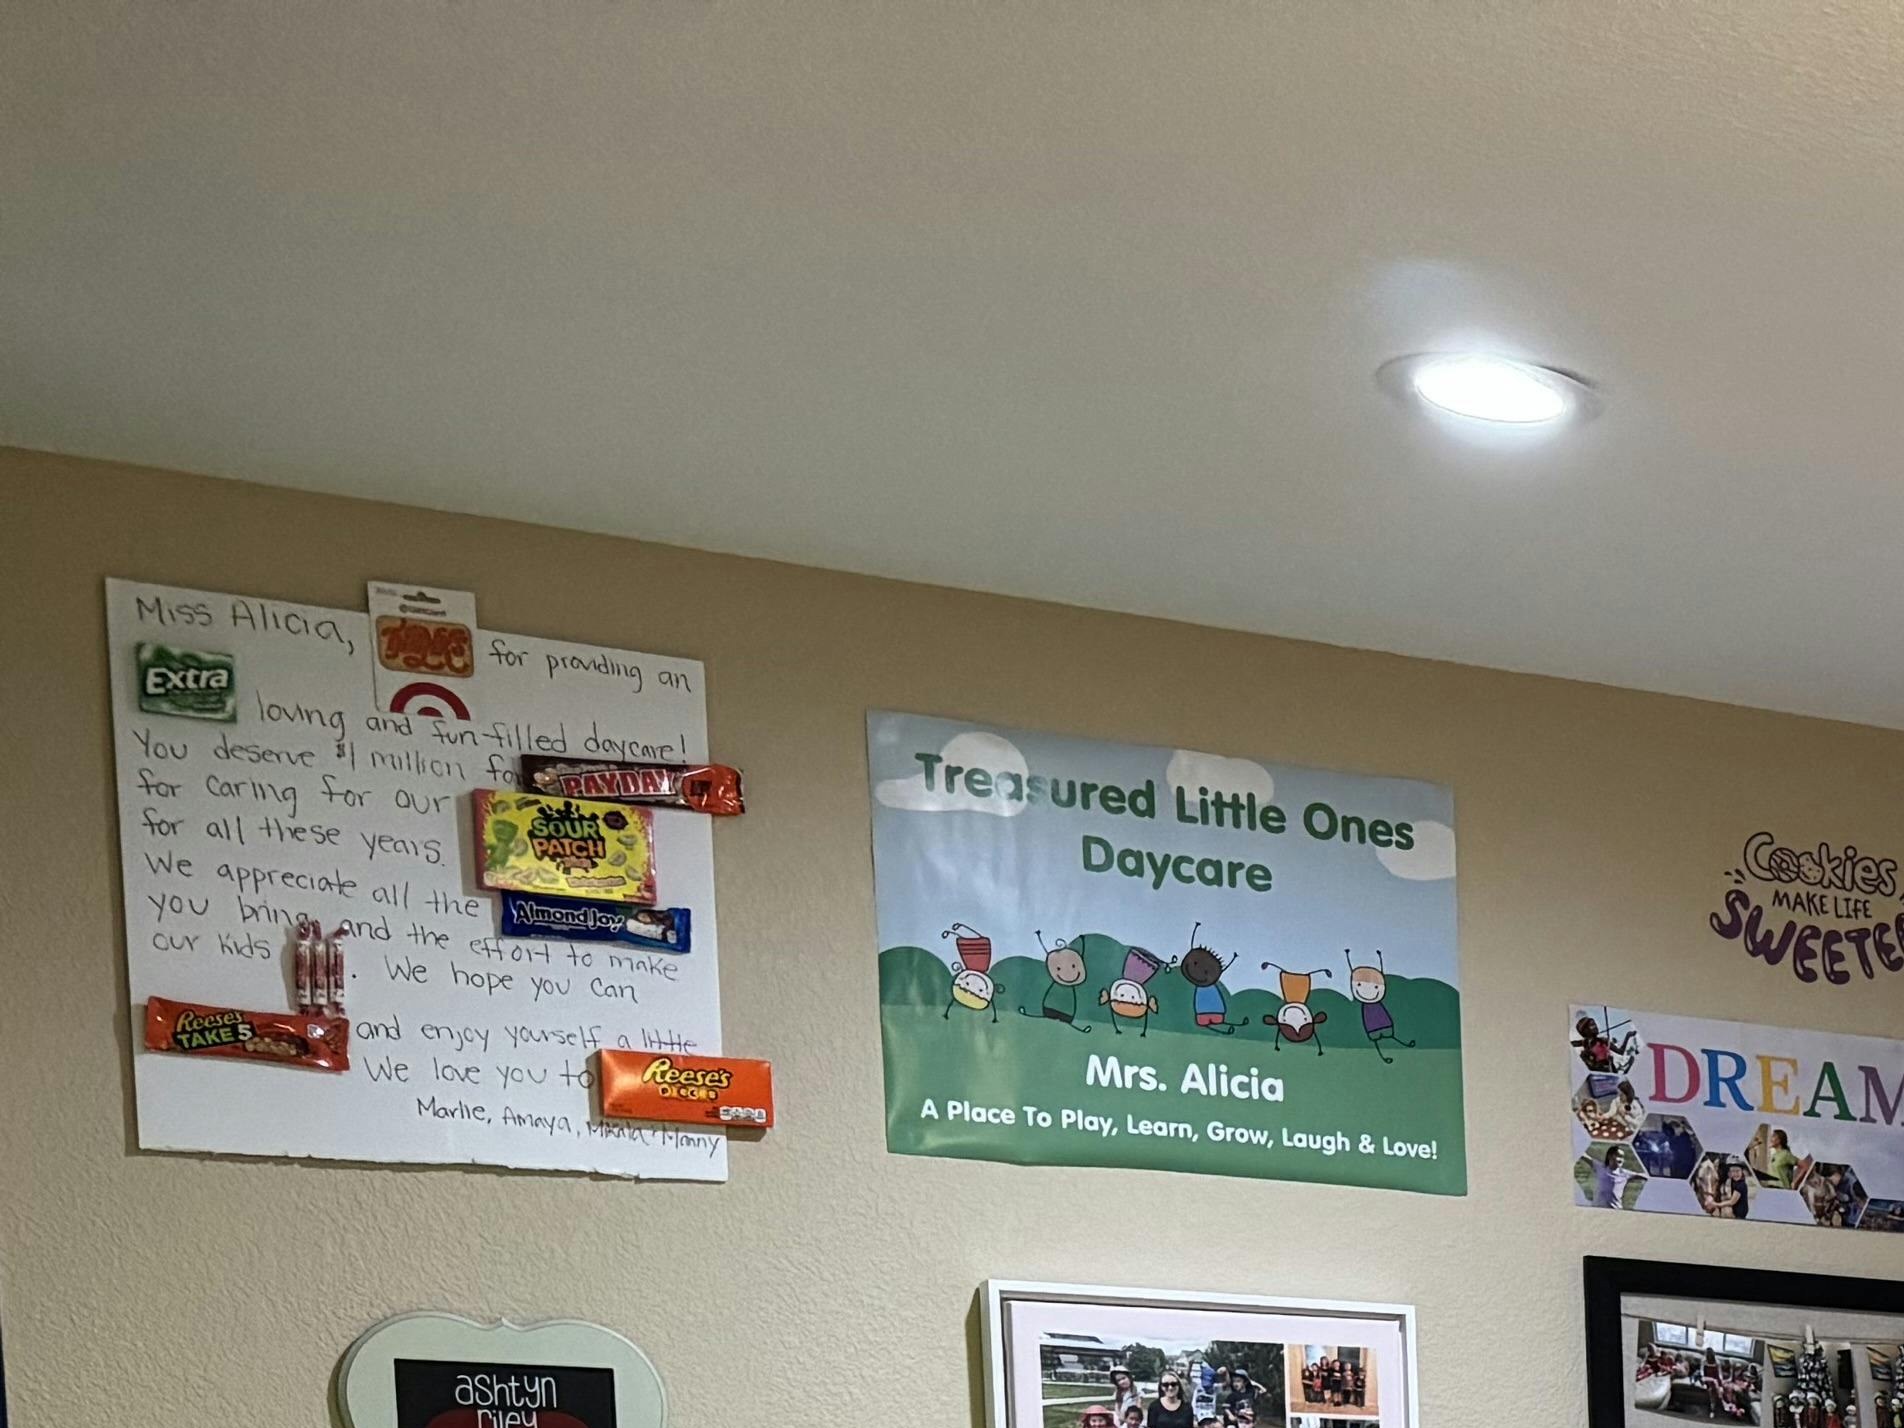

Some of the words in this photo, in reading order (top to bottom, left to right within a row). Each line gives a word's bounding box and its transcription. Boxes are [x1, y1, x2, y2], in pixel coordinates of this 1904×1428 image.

[136, 597, 213, 627] Miss
[488, 638, 529, 667] for
[548, 653, 643, 693] providing
[657, 670, 692, 693] an
[145, 664, 230, 695] Extra
[256, 690, 346, 742] loving
[366, 713, 414, 737] and
[584, 721, 687, 765] daycare!
[132, 728, 188, 761] You
[213, 734, 316, 768] deserve
[370, 749, 467, 782] million
[136, 767, 183, 798] for
[205, 774, 298, 818] caring
[321, 773, 373, 808] for
[394, 788, 451, 815] our
[560, 769, 676, 797] PAYDAY
[914, 752, 1157, 820] Treasured
[1175, 785, 1287, 834] Little
[1302, 802, 1415, 852] Ones
[140, 806, 186, 837] for
[205, 815, 245, 846] all
[258, 816, 341, 846] these
[532, 818, 599, 838] SOUR
[532, 837, 606, 859] PATCH
[143, 851, 194, 878] We
[215, 860, 358, 899] appreciate
[371, 879, 410, 910] all
[425, 890, 479, 919] the
[1081, 834, 1273, 892] Daycare
[1743, 831, 1899, 897] Cookies
[515, 901, 589, 926] Almond
[591, 906, 626, 932] Joy
[1771, 889, 1829, 917] MAKE
[1832, 894, 1873, 919] LIFE
[147, 892, 209, 924] you
[406, 920, 450, 950] the
[469, 935, 551, 965] effort
[566, 942, 594, 968] to
[608, 953, 681, 983] make
[152, 930, 199, 952] our
[219, 930, 272, 960] kids
[386, 954, 428, 984] We
[452, 959, 514, 996] hope
[530, 976, 570, 1002] you
[590, 976, 638, 1004] can
[176, 1027, 233, 1052] TAKE
[237, 1023, 253, 1042] 5
[356, 1014, 402, 1041] and
[421, 1023, 490, 1053] enjoy
[503, 1024, 602, 1052] yourself
[616, 1033, 633, 1051] a
[641, 1028, 698, 1055] little
[364, 1056, 410, 1084] We
[432, 1056, 482, 1084] love
[495, 1066, 547, 1091] you
[641, 1056, 732, 1089] Reese's
[1085, 1053, 1167, 1093] Mrs.
[1180, 1065, 1285, 1103] Alicia
[920, 1099, 939, 1120] A
[946, 1100, 1016, 1127] Place
[1022, 1106, 1053, 1129] To
[1060, 1107, 1119, 1139] Play,
[1126, 1113, 1200, 1142] Learn,
[1206, 1120, 1275, 1149] Grow,
[1281, 1127, 1352, 1156] Laugh
[1358, 1133, 1376, 1153] &
[1382, 1138, 1438, 1160] Love!
[454, 1373, 558, 1409] ashtyn
